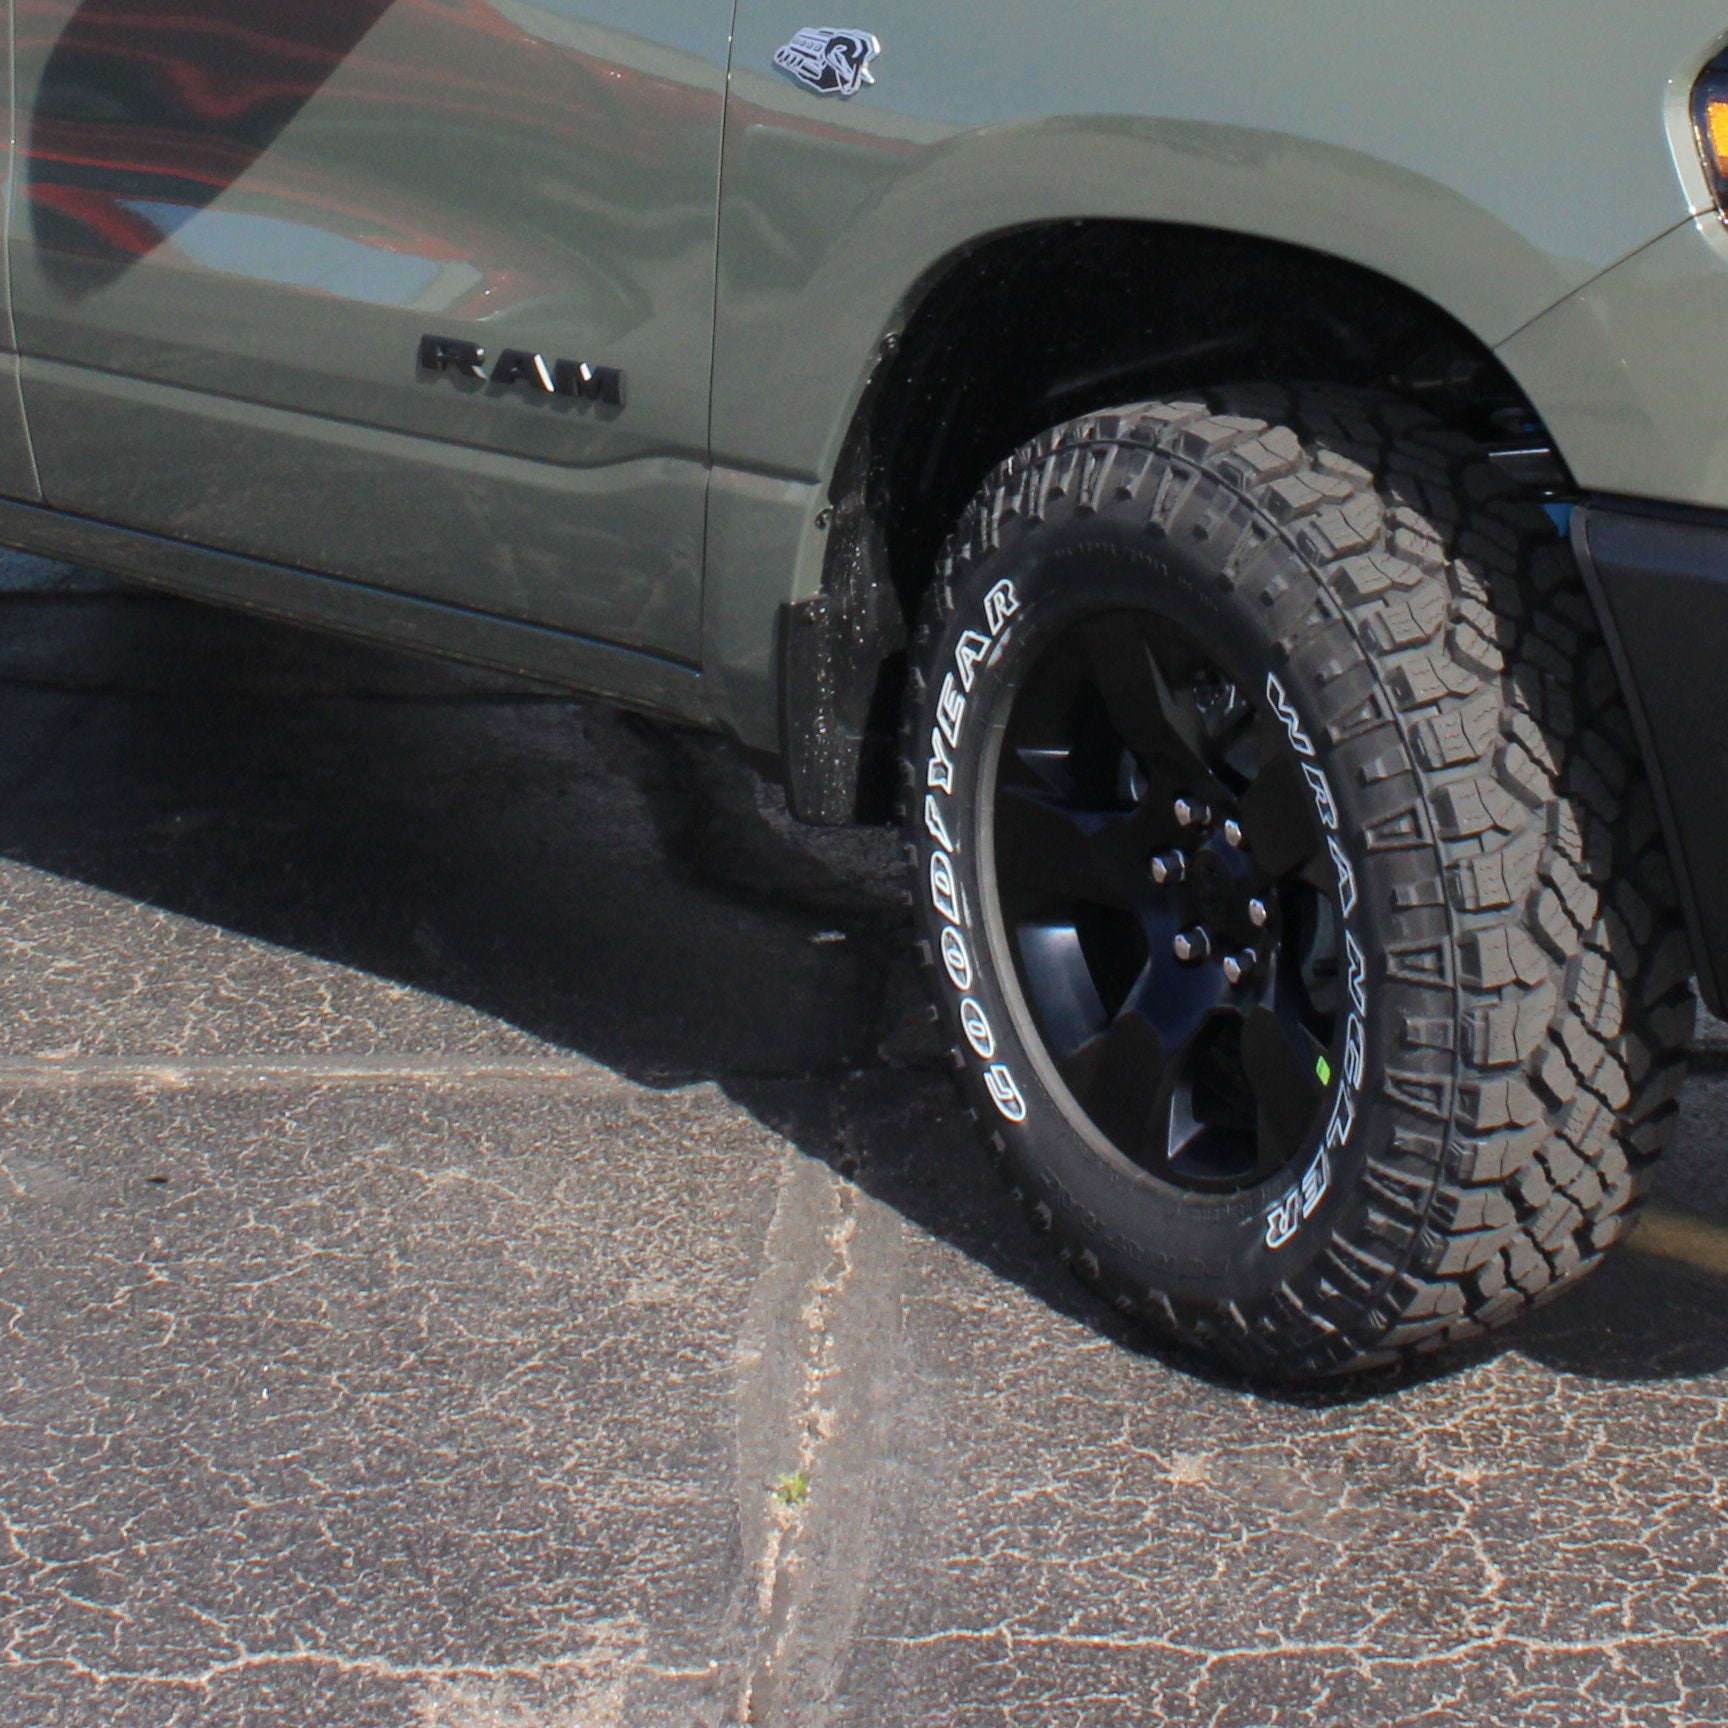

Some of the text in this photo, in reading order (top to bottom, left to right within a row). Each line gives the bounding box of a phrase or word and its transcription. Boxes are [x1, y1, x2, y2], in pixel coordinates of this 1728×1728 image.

[416, 333, 626, 410] RAM
[924, 578, 1027, 1122] GOODYEAR
[1265, 672, 1367, 1249] WRANGLER
